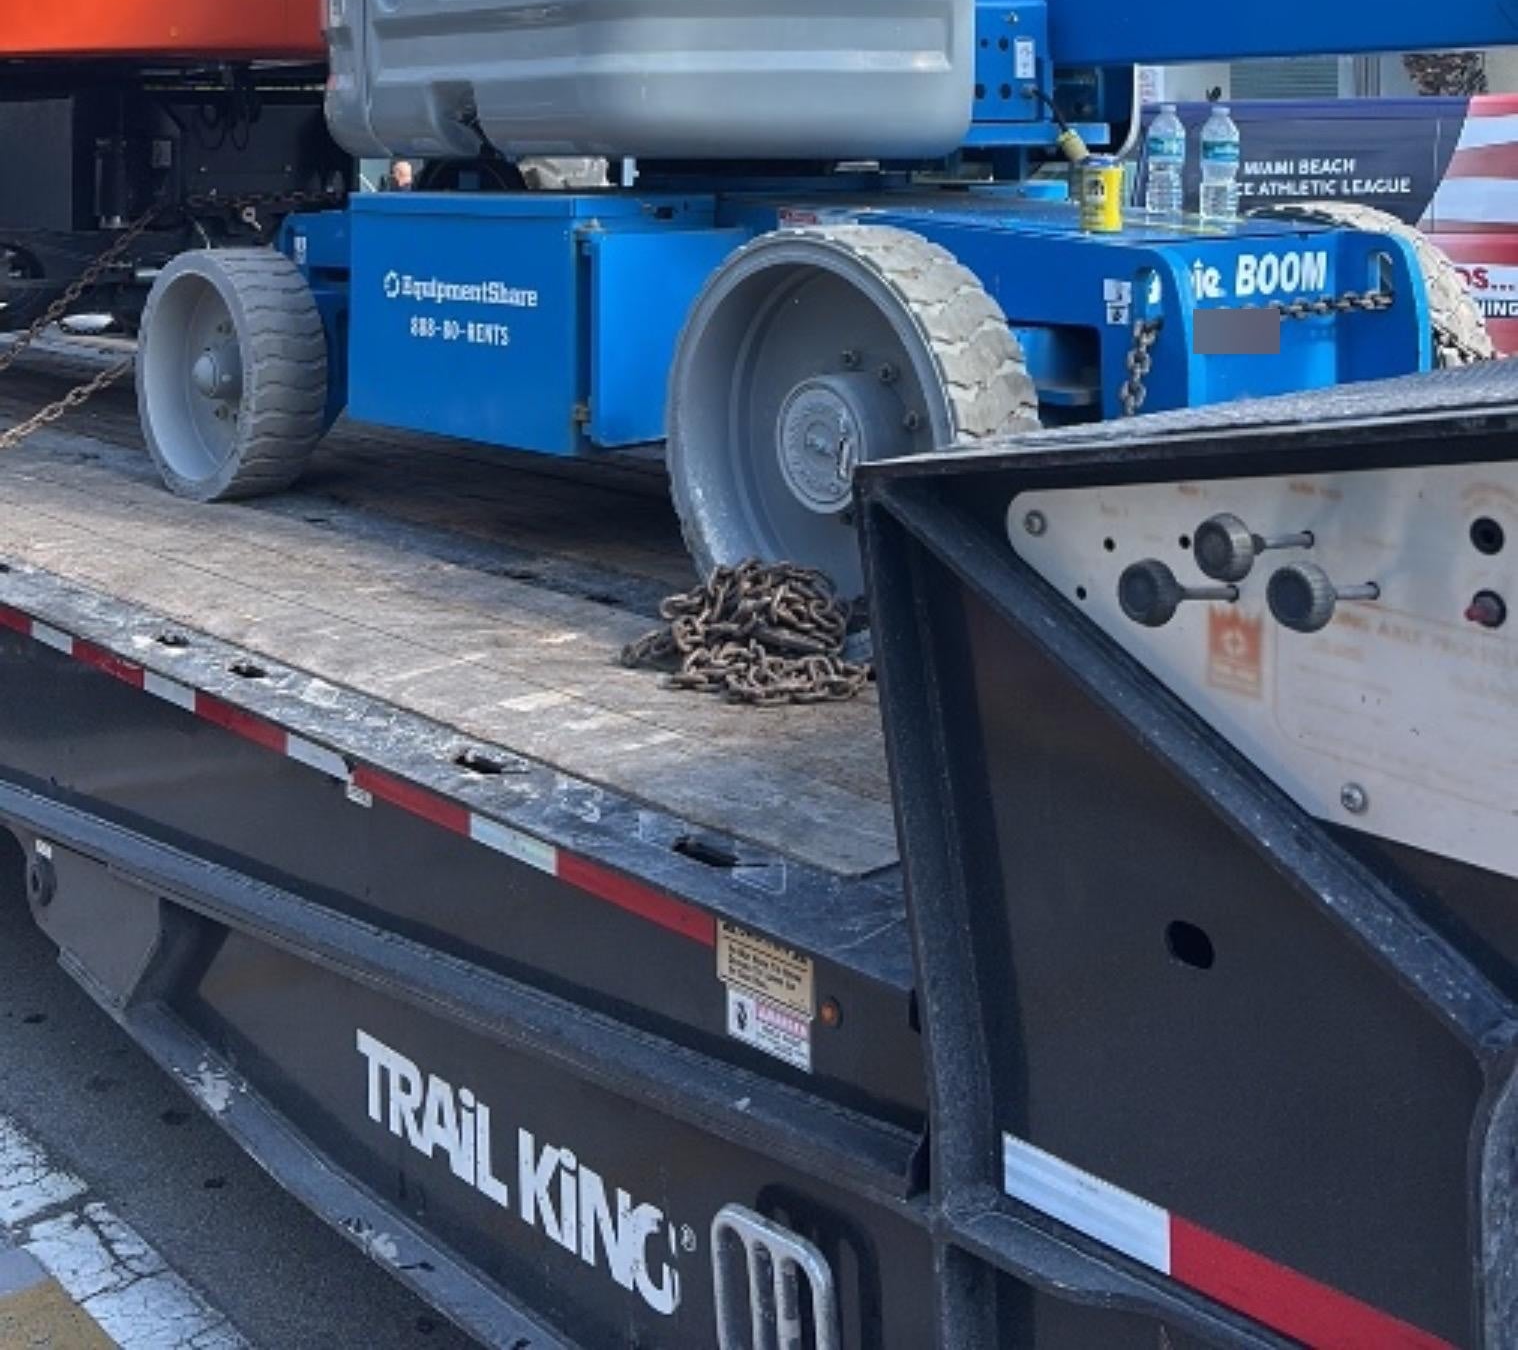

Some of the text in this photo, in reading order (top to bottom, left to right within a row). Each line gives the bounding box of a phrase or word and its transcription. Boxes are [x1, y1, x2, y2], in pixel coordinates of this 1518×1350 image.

[1244, 158, 1357, 175] MIAMI BEACH
[1236, 177, 1411, 196] CE ATHLETIC LEAGUE
[1235, 251, 1327, 297] BOOM
[401, 275, 539, 306] EquipmentShare
